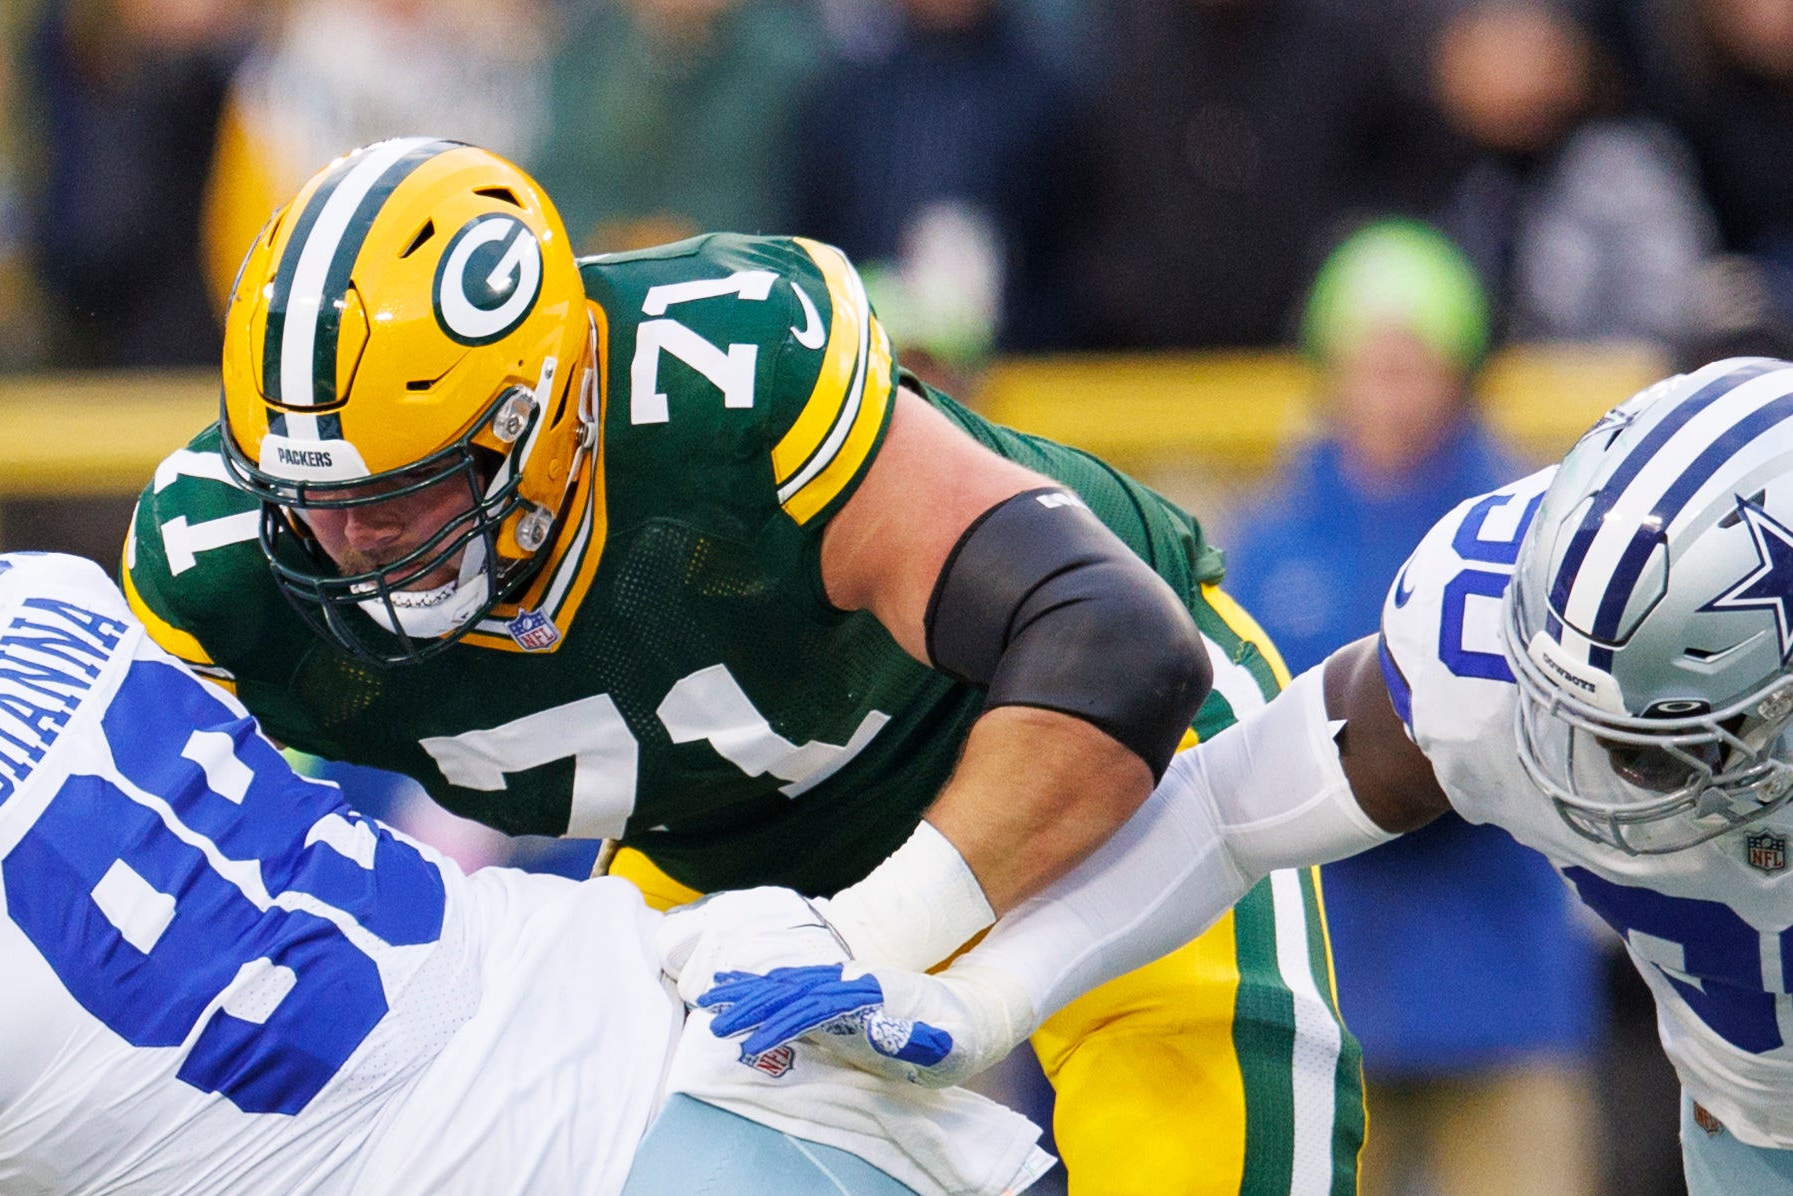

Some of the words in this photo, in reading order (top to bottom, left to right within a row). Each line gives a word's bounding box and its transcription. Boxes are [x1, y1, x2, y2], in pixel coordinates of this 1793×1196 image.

[631, 270, 780, 425] 71
[277, 447, 333, 468] PACKERS
[521, 627, 555, 648] NFL
[1543, 652, 1596, 693] COWBOYS
[418, 664, 892, 841] 71
[1752, 849, 1783, 869] NFL
[3, 660, 446, 1117] 98
[757, 1047, 791, 1075] NFL
